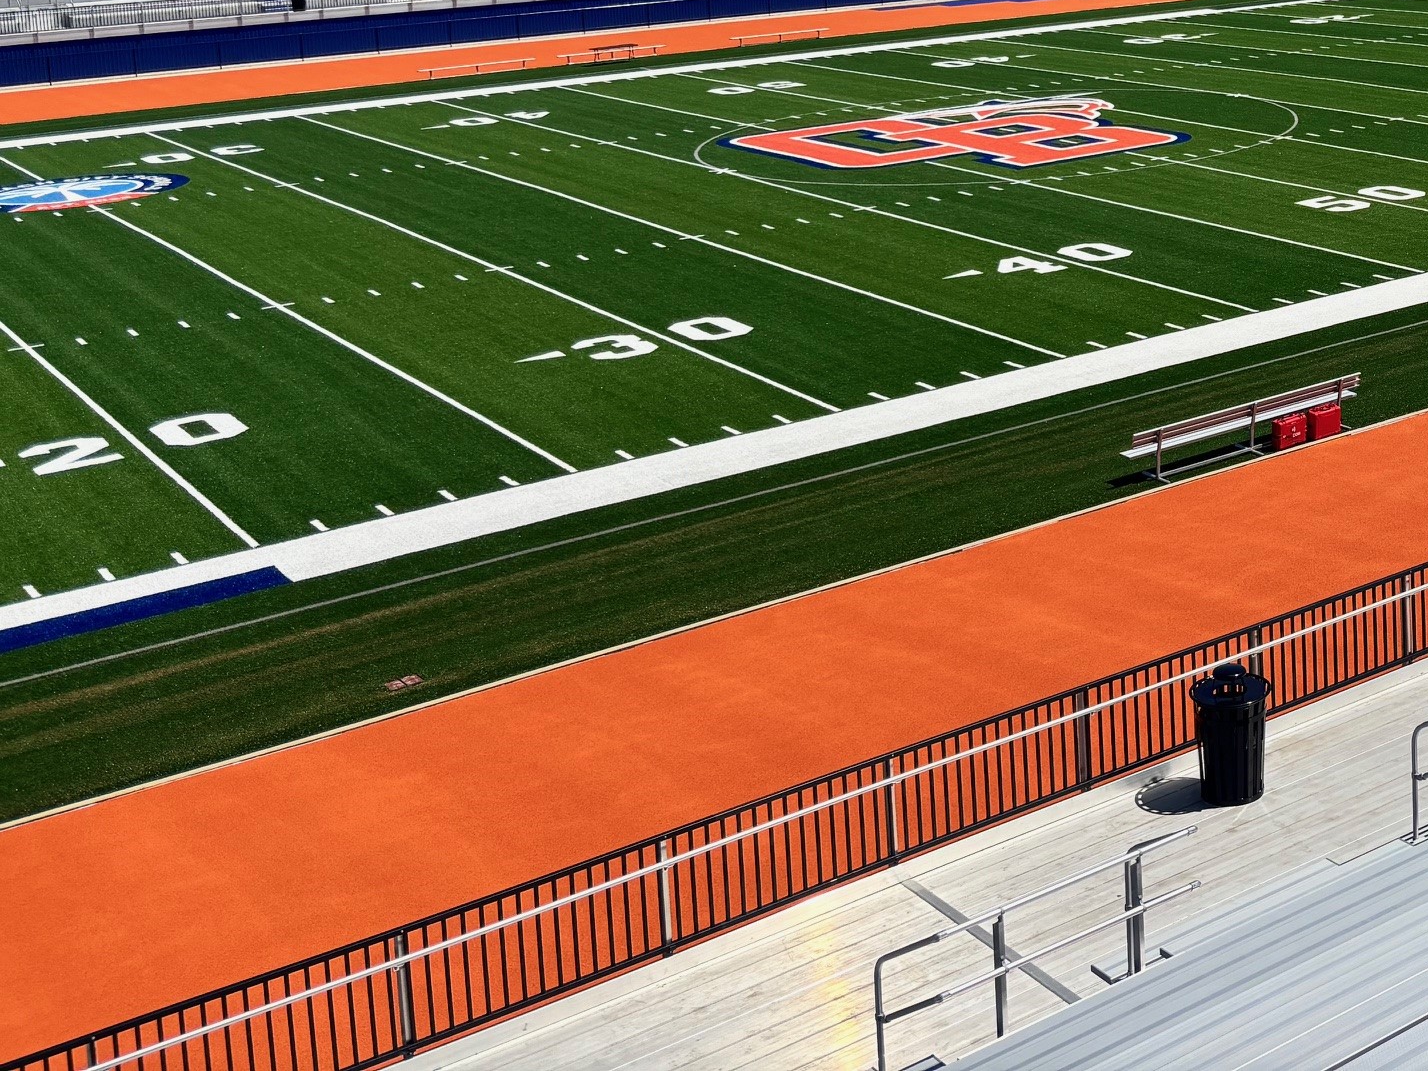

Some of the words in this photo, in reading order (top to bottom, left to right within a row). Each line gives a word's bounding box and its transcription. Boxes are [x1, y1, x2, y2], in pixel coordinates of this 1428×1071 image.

[1296, 185, 1426, 212] 50
[996, 242, 1133, 274] 40
[570, 316, 753, 360] 30
[18, 412, 250, 476] 20
